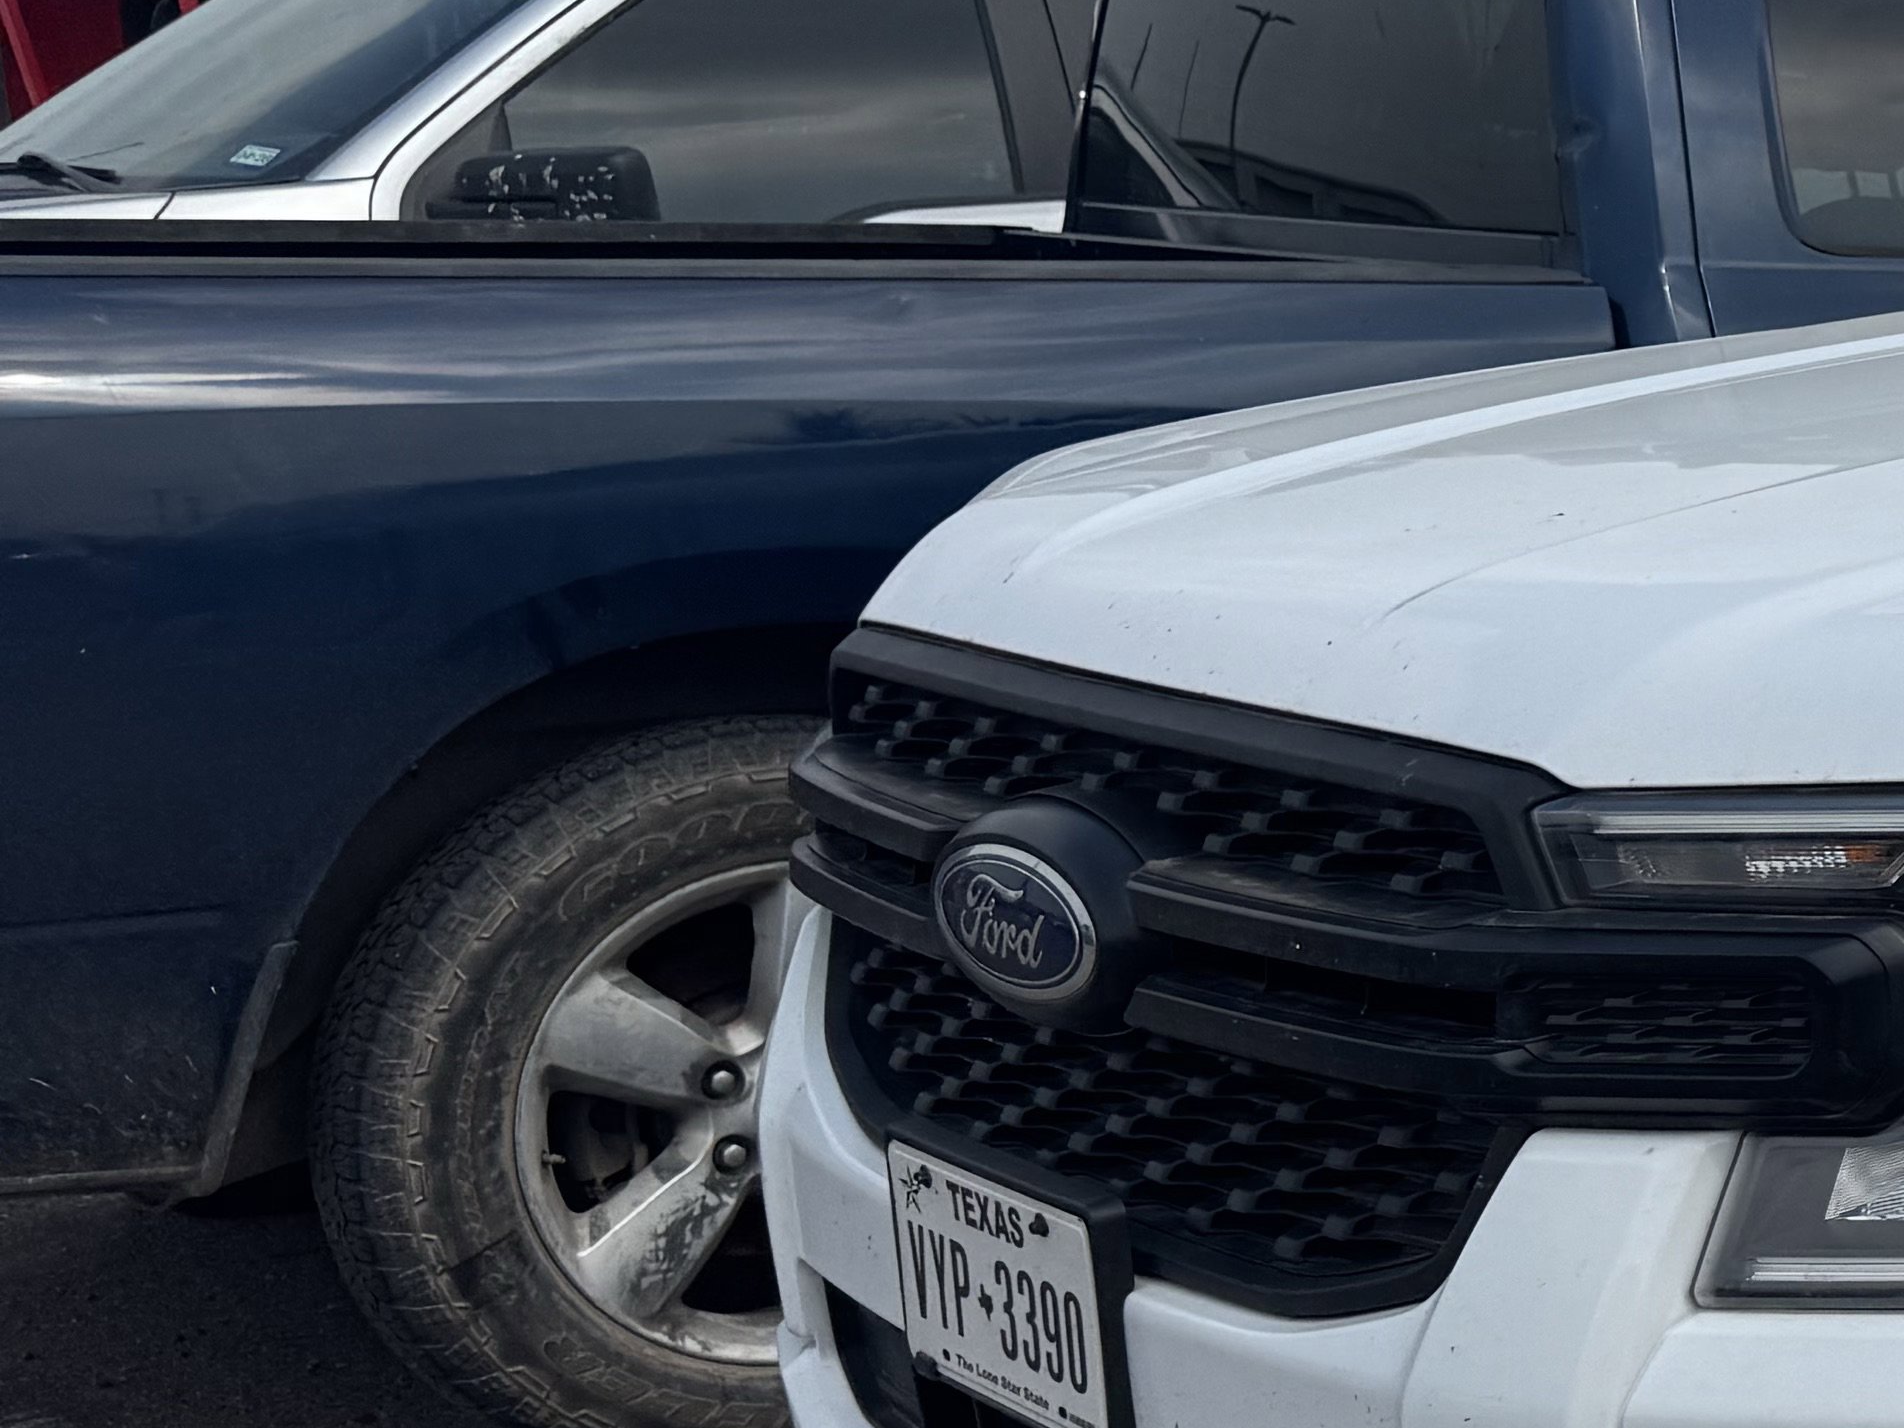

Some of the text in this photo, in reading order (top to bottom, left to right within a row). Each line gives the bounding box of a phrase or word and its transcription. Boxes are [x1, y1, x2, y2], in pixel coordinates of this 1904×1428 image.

[960, 872, 1043, 969] Ford
[944, 1179, 1026, 1249] TEXAS
[906, 1219, 1089, 1395] VYP 3390
[954, 1352, 974, 1374] The
[1000, 1375, 1022, 1397] Star
[1023, 1386, 1050, 1411] State
